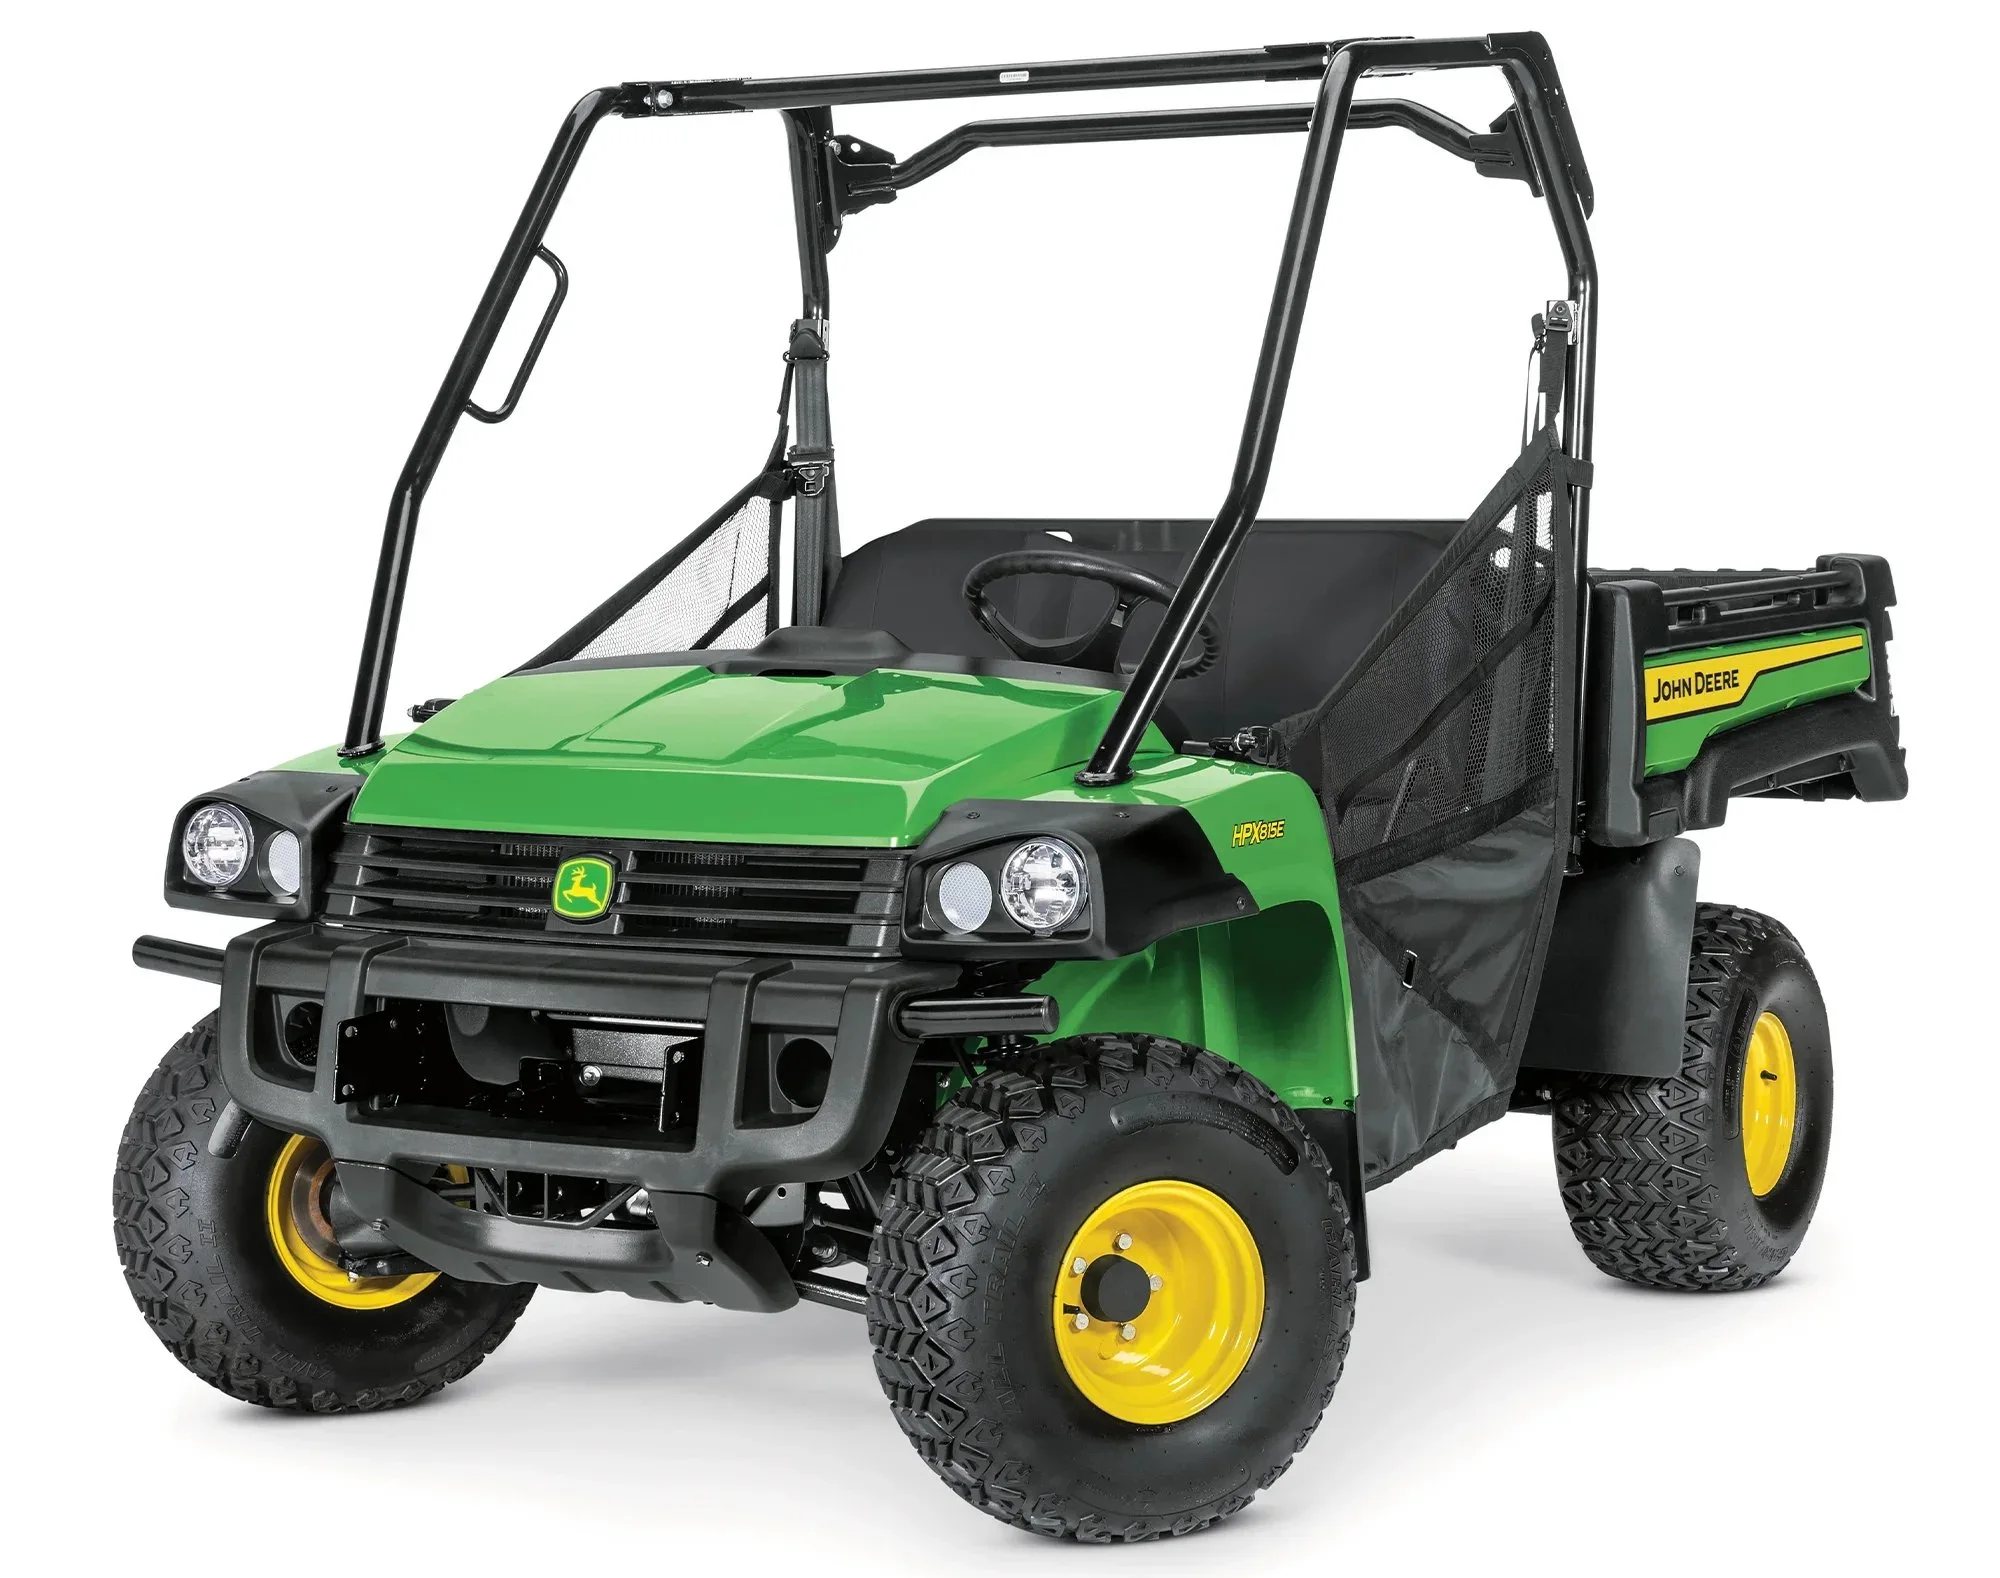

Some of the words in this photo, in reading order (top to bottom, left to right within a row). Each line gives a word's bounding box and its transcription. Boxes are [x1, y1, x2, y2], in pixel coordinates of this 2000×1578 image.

[1653, 678, 1692, 703] JOHN
[1694, 669, 1739, 694] DEERE
[1231, 819, 1285, 848] HPX815E
[206, 1254, 264, 1345] TRAIL
[983, 1215, 1026, 1325] TRAIL
